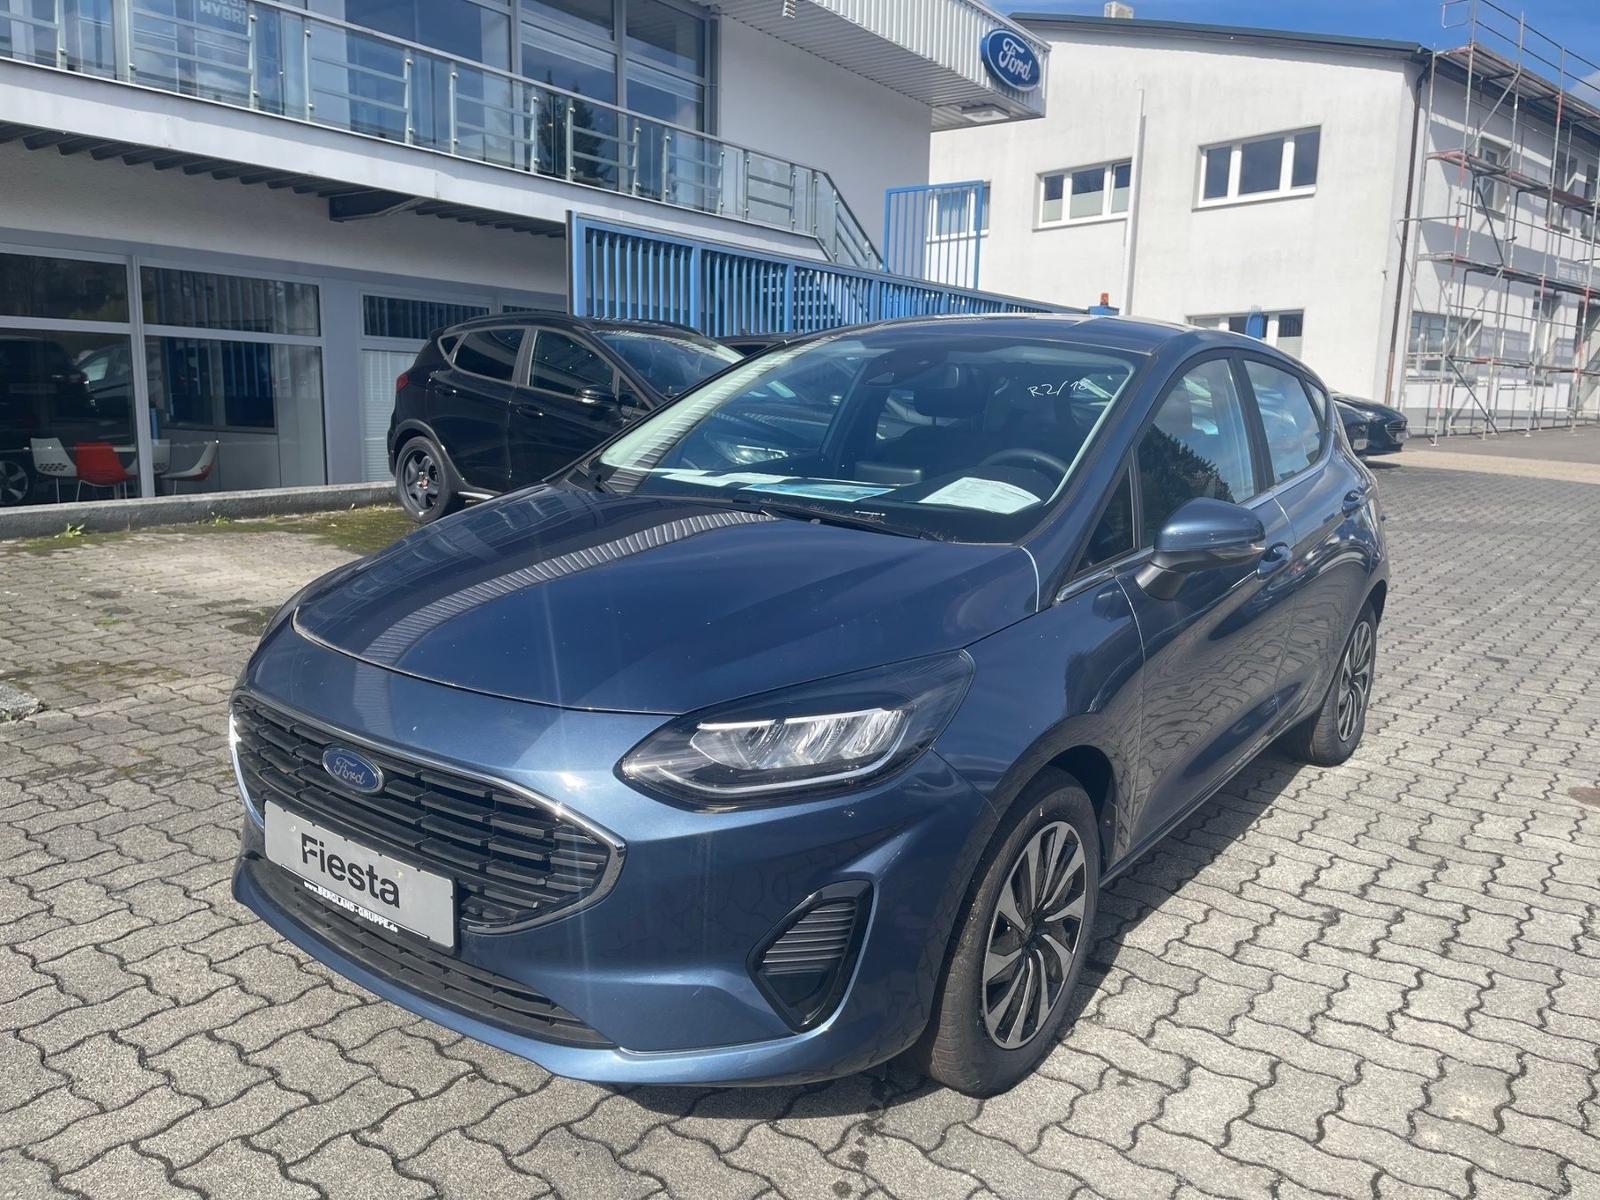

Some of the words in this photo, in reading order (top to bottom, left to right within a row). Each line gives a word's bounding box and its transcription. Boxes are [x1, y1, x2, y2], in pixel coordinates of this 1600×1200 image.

[200, 1, 248, 25] HYBRI
[998, 37, 1032, 81] Ford
[333, 756, 366, 785] Ford
[301, 832, 400, 909] Fiesta
